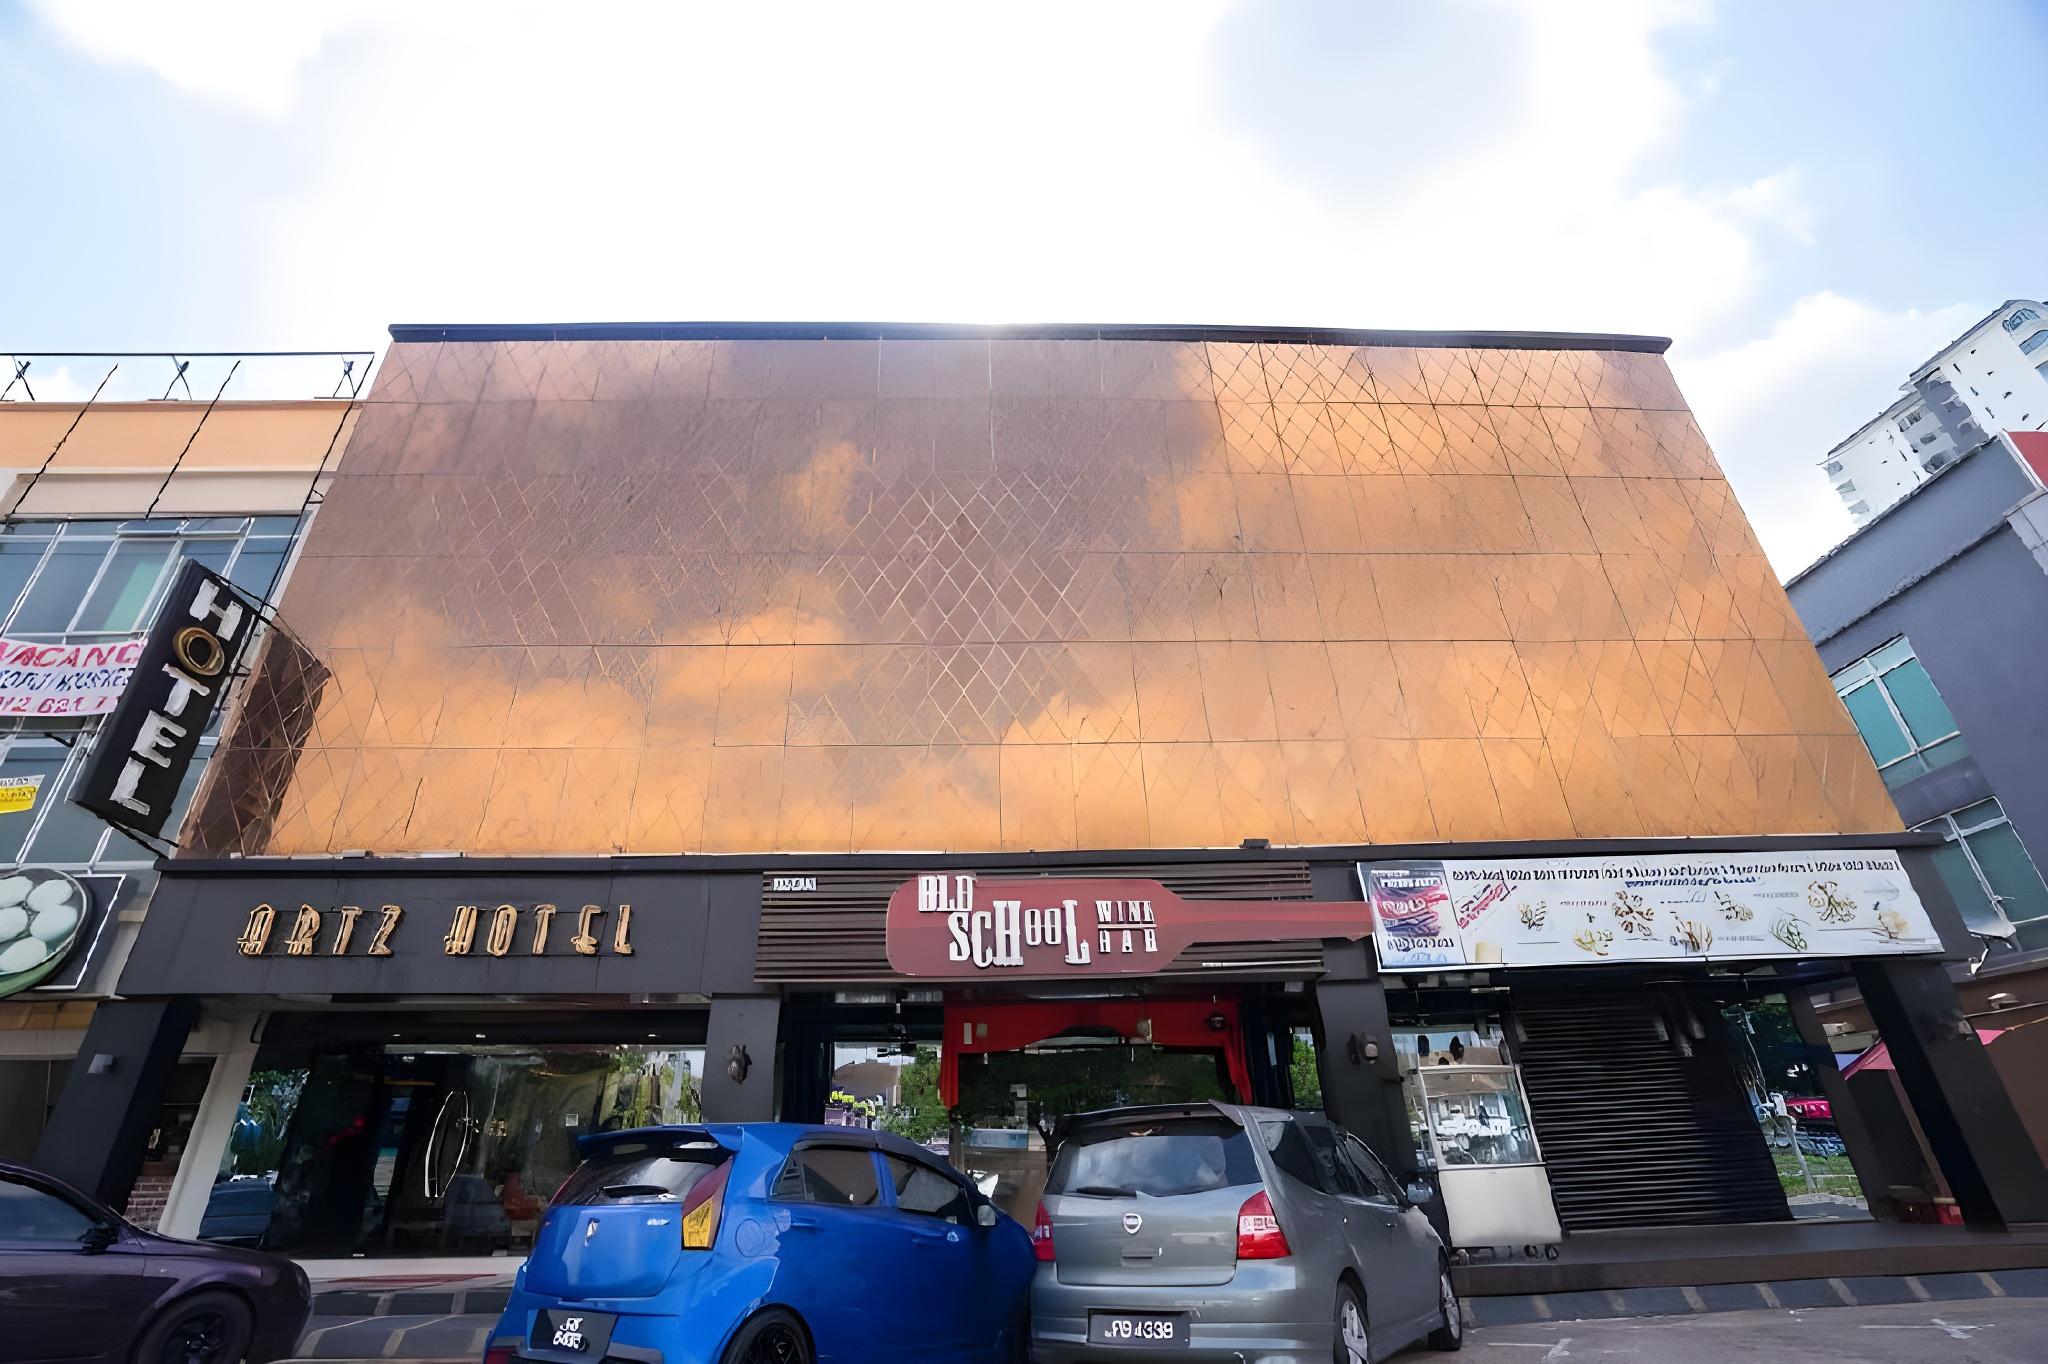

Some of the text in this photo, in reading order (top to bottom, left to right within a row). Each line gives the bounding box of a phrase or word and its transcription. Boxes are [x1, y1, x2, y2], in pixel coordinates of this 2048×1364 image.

[109, 578, 243, 816] HOTEL
[918, 875, 974, 912] OLD
[236, 902, 635, 956] ARTZ HOTEL
